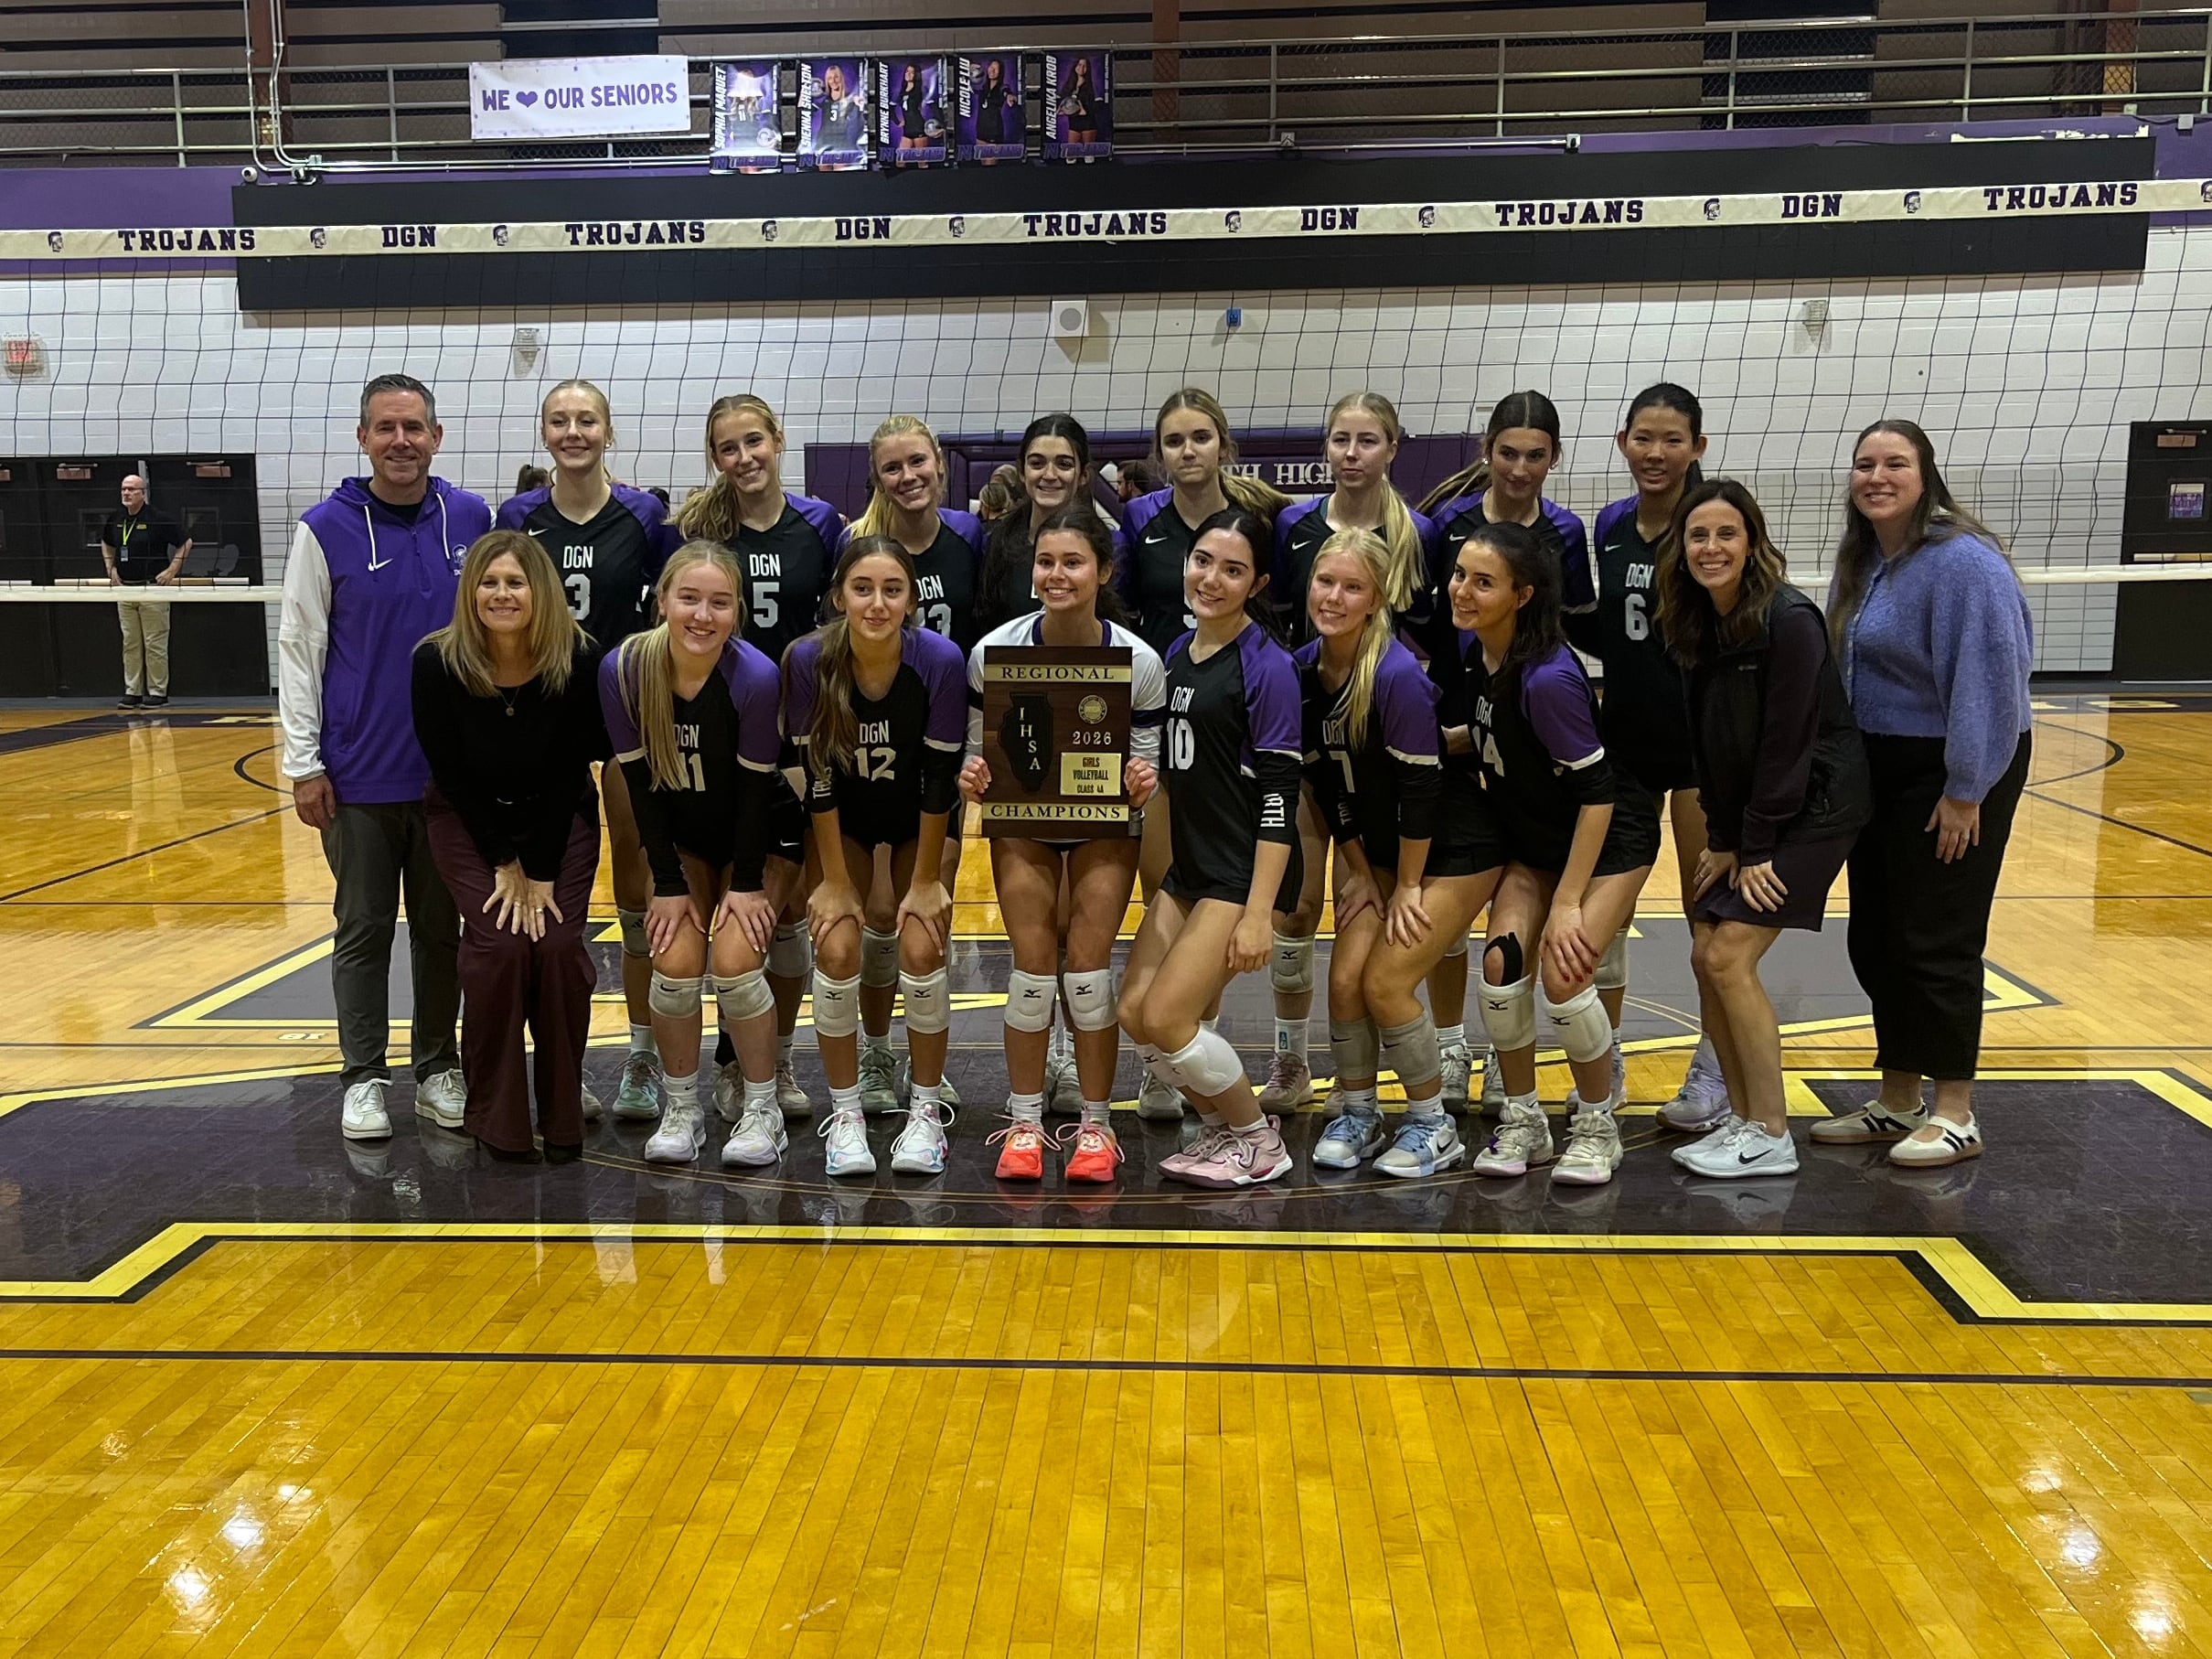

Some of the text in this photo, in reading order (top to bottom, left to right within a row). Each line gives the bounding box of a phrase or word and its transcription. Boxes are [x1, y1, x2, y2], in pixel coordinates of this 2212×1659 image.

[482, 82, 678, 111] WE OUR SENIORS
[880, 61, 890, 144] BRYNNE BURKHART
[959, 58, 970, 117] NICOLE LIU
[1046, 55, 1057, 139] ANGELIKA KROB
[715, 66, 726, 148] SOPHIA MAQUET
[801, 63, 812, 147] SIENNA SHELTON
[118, 183, 2138, 252] TROJANS DGN TROJANS DGN TROJANS DGN TROJANS DGN TROJANS
[563, 546, 593, 569] DGN
[749, 553, 781, 577] DGN
[1625, 562, 1655, 589] DGN
[564, 573, 591, 620] 3
[753, 582, 780, 628] 5
[1625, 593, 1649, 640] 6
[1002, 667, 1115, 680] REGIONAL
[1170, 686, 1195, 713] DGN
[673, 723, 700, 748] DGN
[860, 720, 889, 744] DGN
[1073, 731, 1112, 745] 2026
[1166, 717, 1195, 770] 10
[854, 746, 896, 781] 12
[1073, 769, 1108, 781] VOLLEYBALL
[1329, 750, 1355, 793] 7
[1077, 785, 1095, 794] CLASS
[990, 805, 1121, 819] CHAMPIONS
